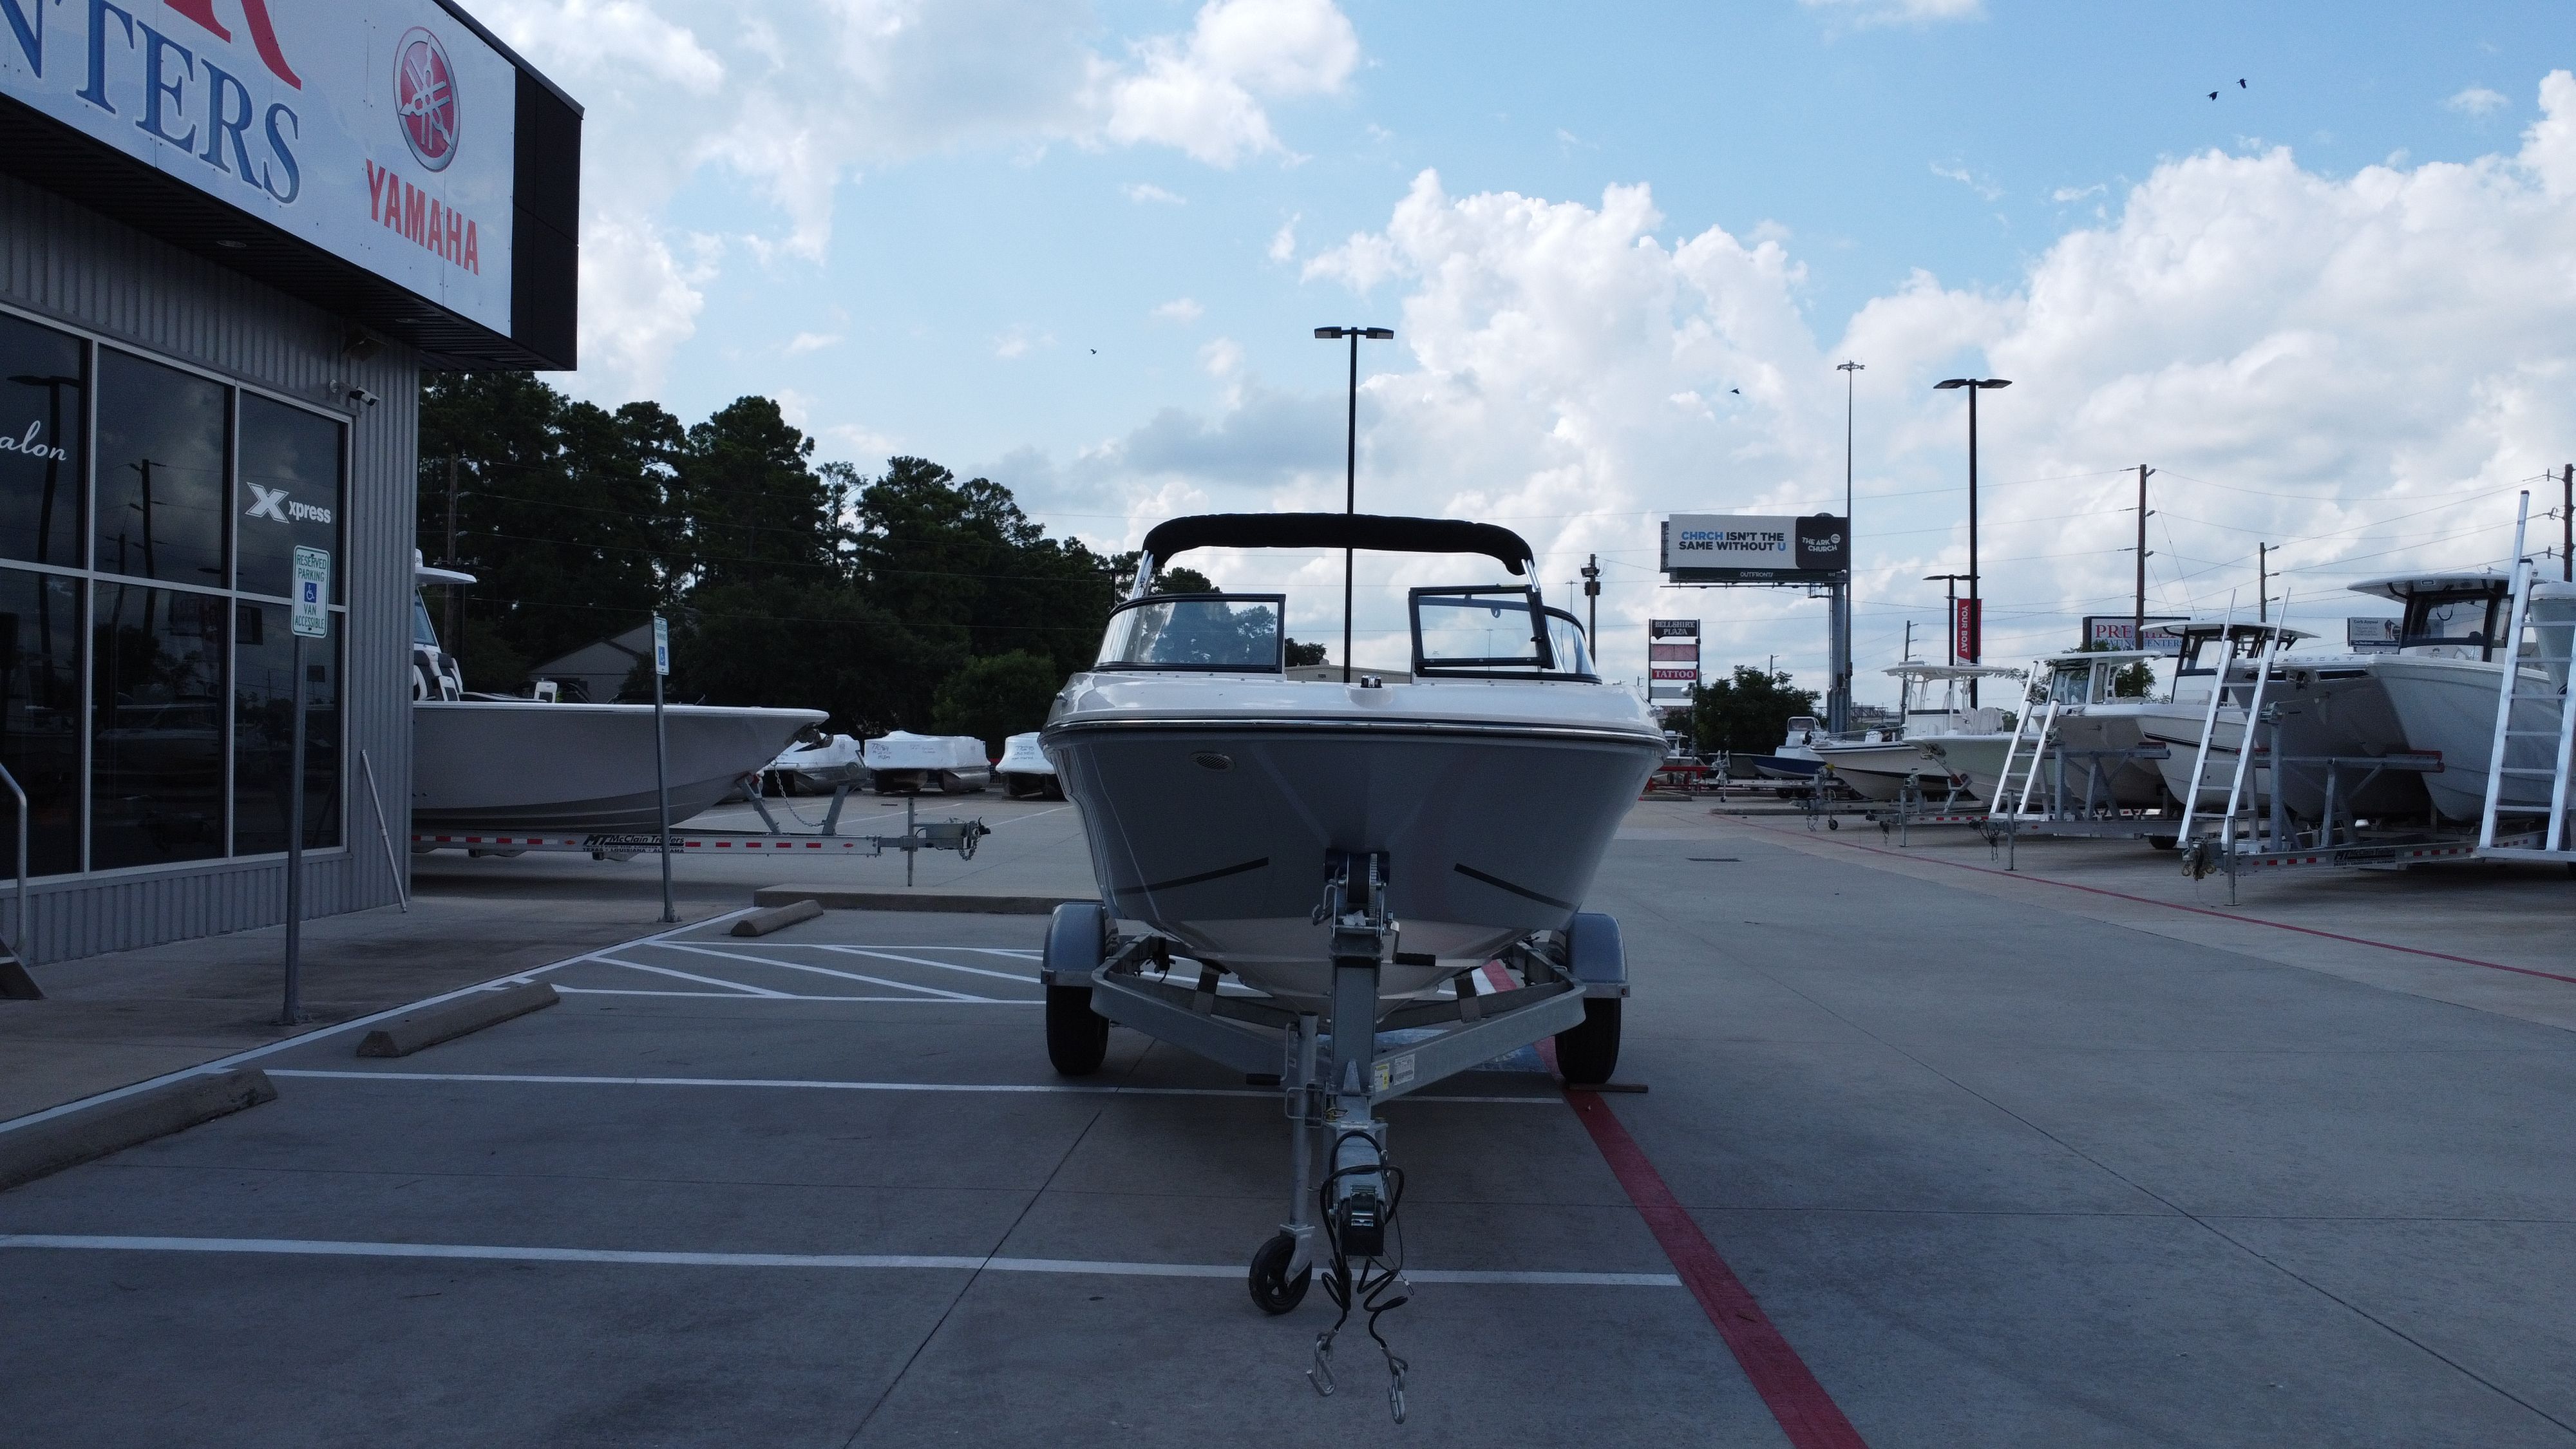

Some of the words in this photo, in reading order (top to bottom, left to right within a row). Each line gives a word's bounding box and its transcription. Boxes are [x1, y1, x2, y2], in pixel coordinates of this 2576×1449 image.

[366, 158, 479, 276] YAMAHA
[289, 500, 331, 524] xpress
[1681, 531, 1723, 541] CHRCH
[1726, 531, 1756, 542] ISN'T
[1760, 532, 1785, 542] THE
[1801, 536, 1815, 545] THE
[1678, 541, 1713, 551] SAME
[1713, 542, 1774, 552] WITHOUT
[1777, 542, 1786, 552] U
[1808, 544, 1838, 553] CHURCH
[296, 554, 327, 570] RESERVED
[298, 568, 325, 583] PARKING
[303, 603, 317, 616] VAN
[294, 615, 325, 630] ACCESSIBLE
[1654, 670, 1694, 678] TATTOO
[609, 835, 648, 843] McClain
